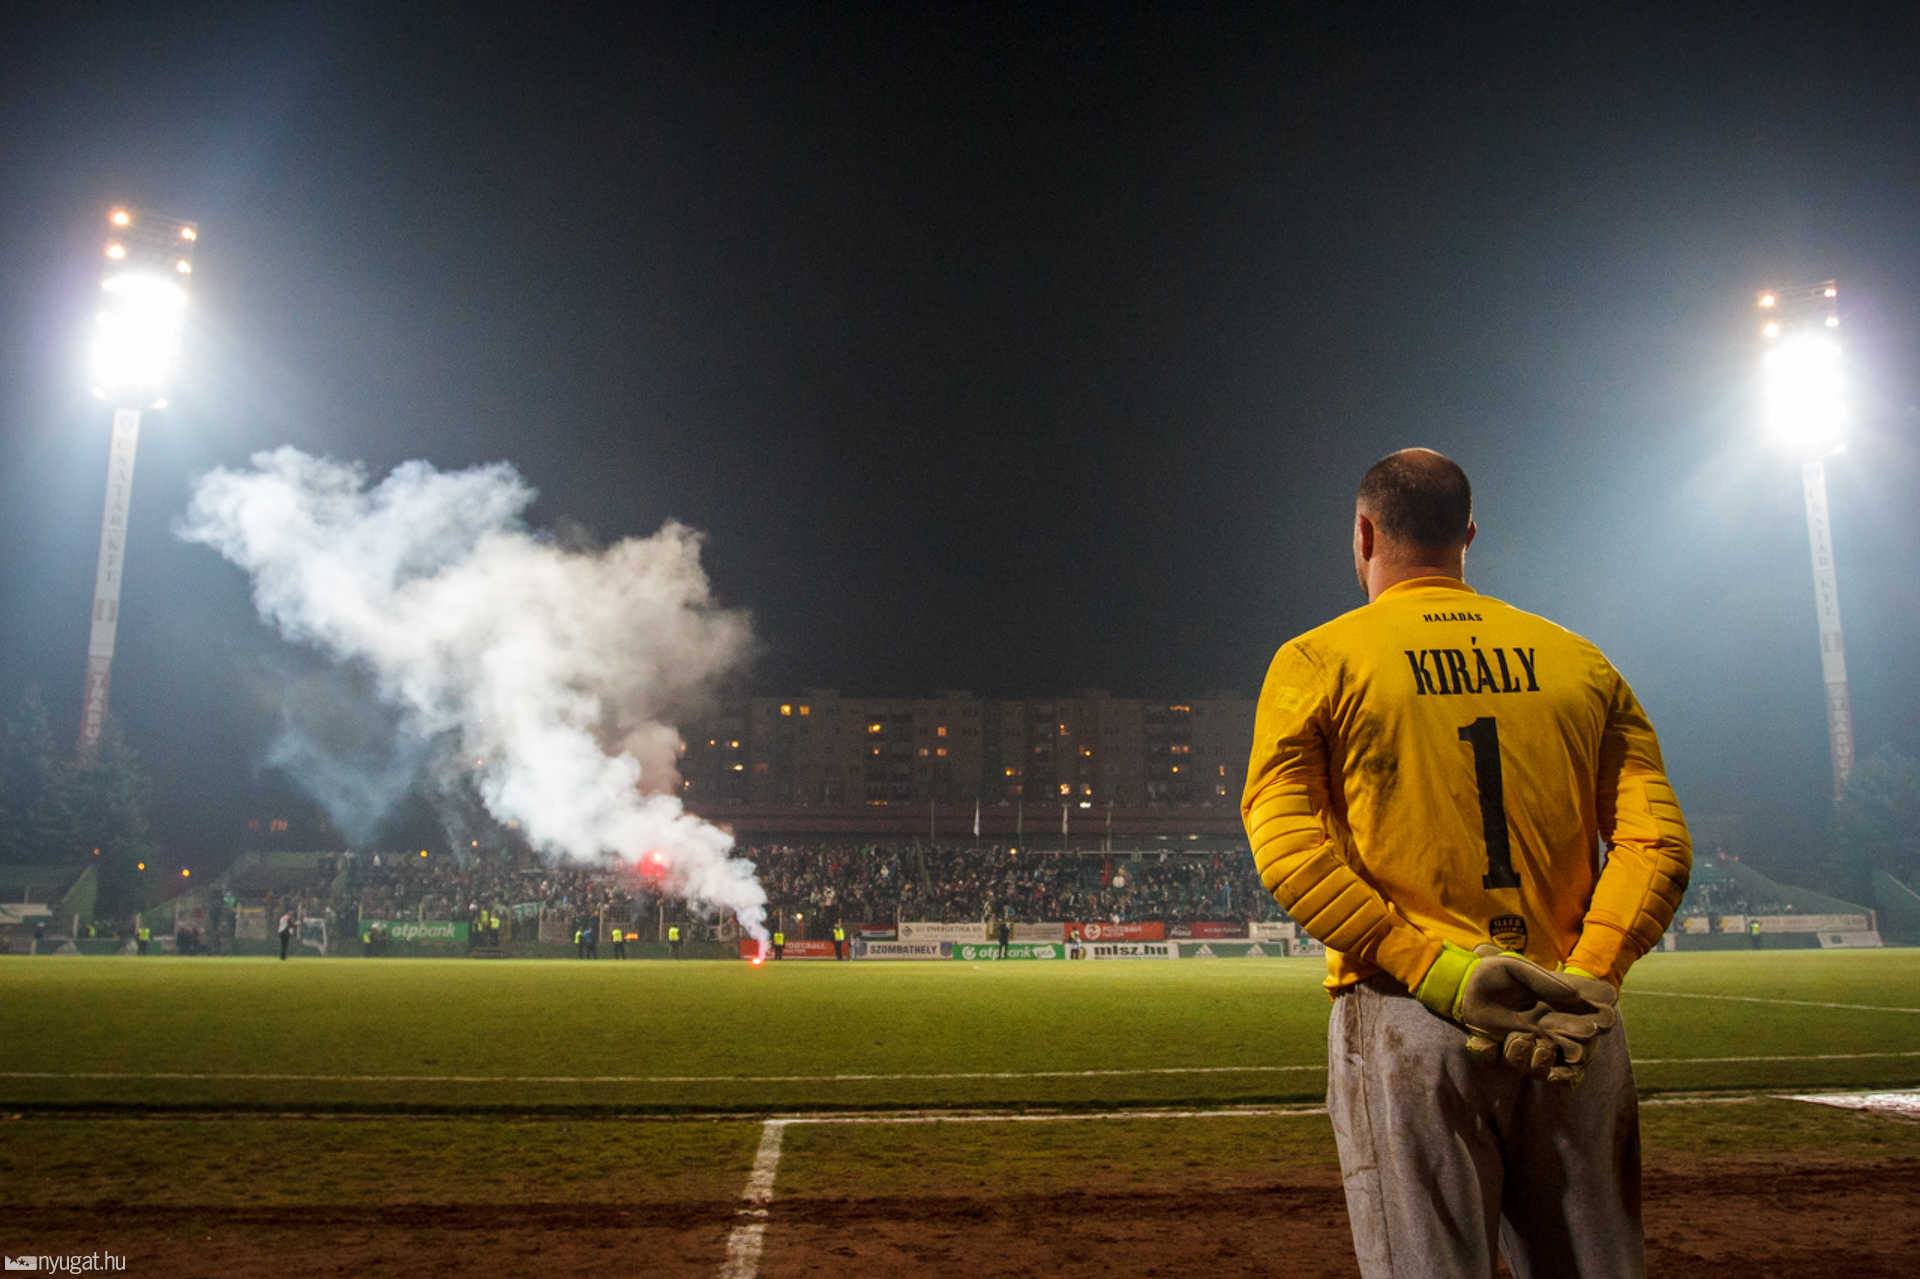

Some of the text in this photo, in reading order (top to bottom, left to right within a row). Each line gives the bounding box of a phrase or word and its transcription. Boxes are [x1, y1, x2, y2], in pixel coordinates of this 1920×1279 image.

[1404, 636, 1541, 695] KIRÁLY
[1457, 716, 1521, 889] 1
[870, 945, 937, 954] SZOMBATHELY
[978, 945, 1031, 960] otpank
[1093, 945, 1168, 955] mlsz.hu
